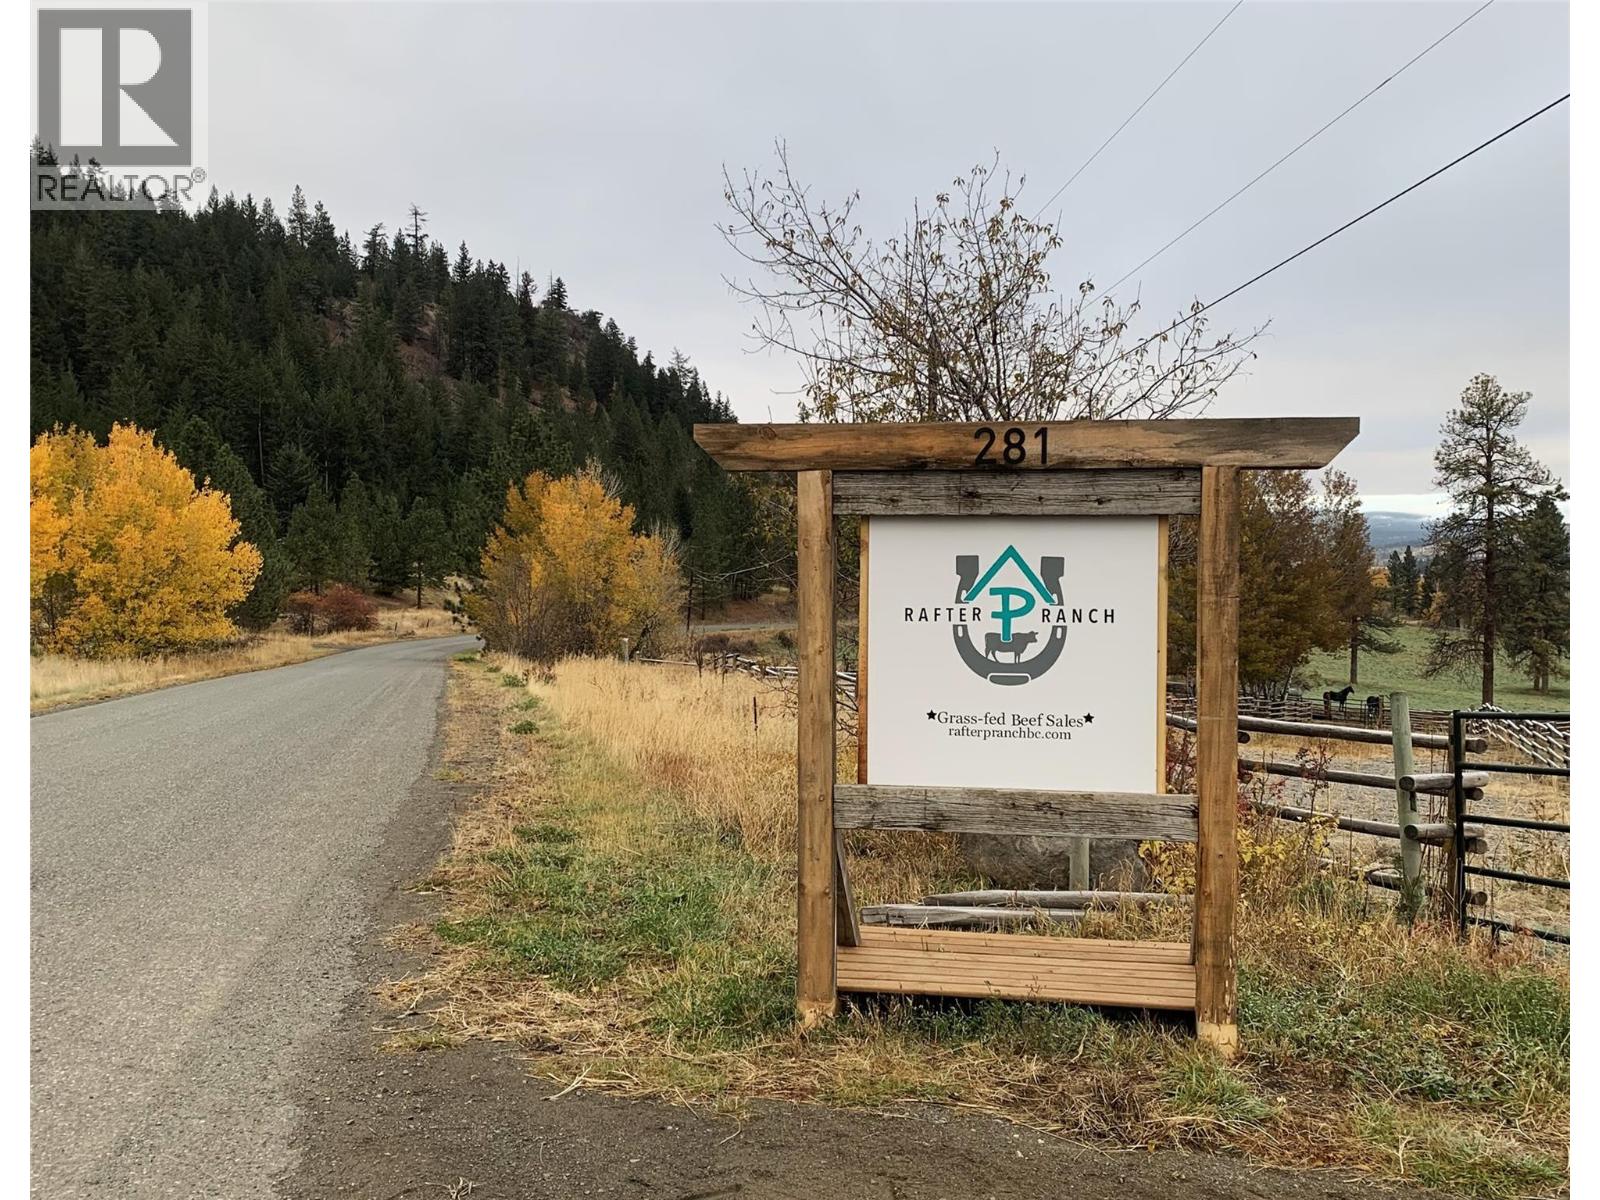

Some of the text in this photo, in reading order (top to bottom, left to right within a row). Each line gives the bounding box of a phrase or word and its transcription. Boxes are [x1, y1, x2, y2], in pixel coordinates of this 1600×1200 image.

[974, 426, 1048, 465] 281
[904, 586, 1115, 642] RAFTER P RANCH
[937, 711, 1084, 728] Grass-fed Beef Sales
[948, 725, 1072, 741] rafterpranchbc.com
